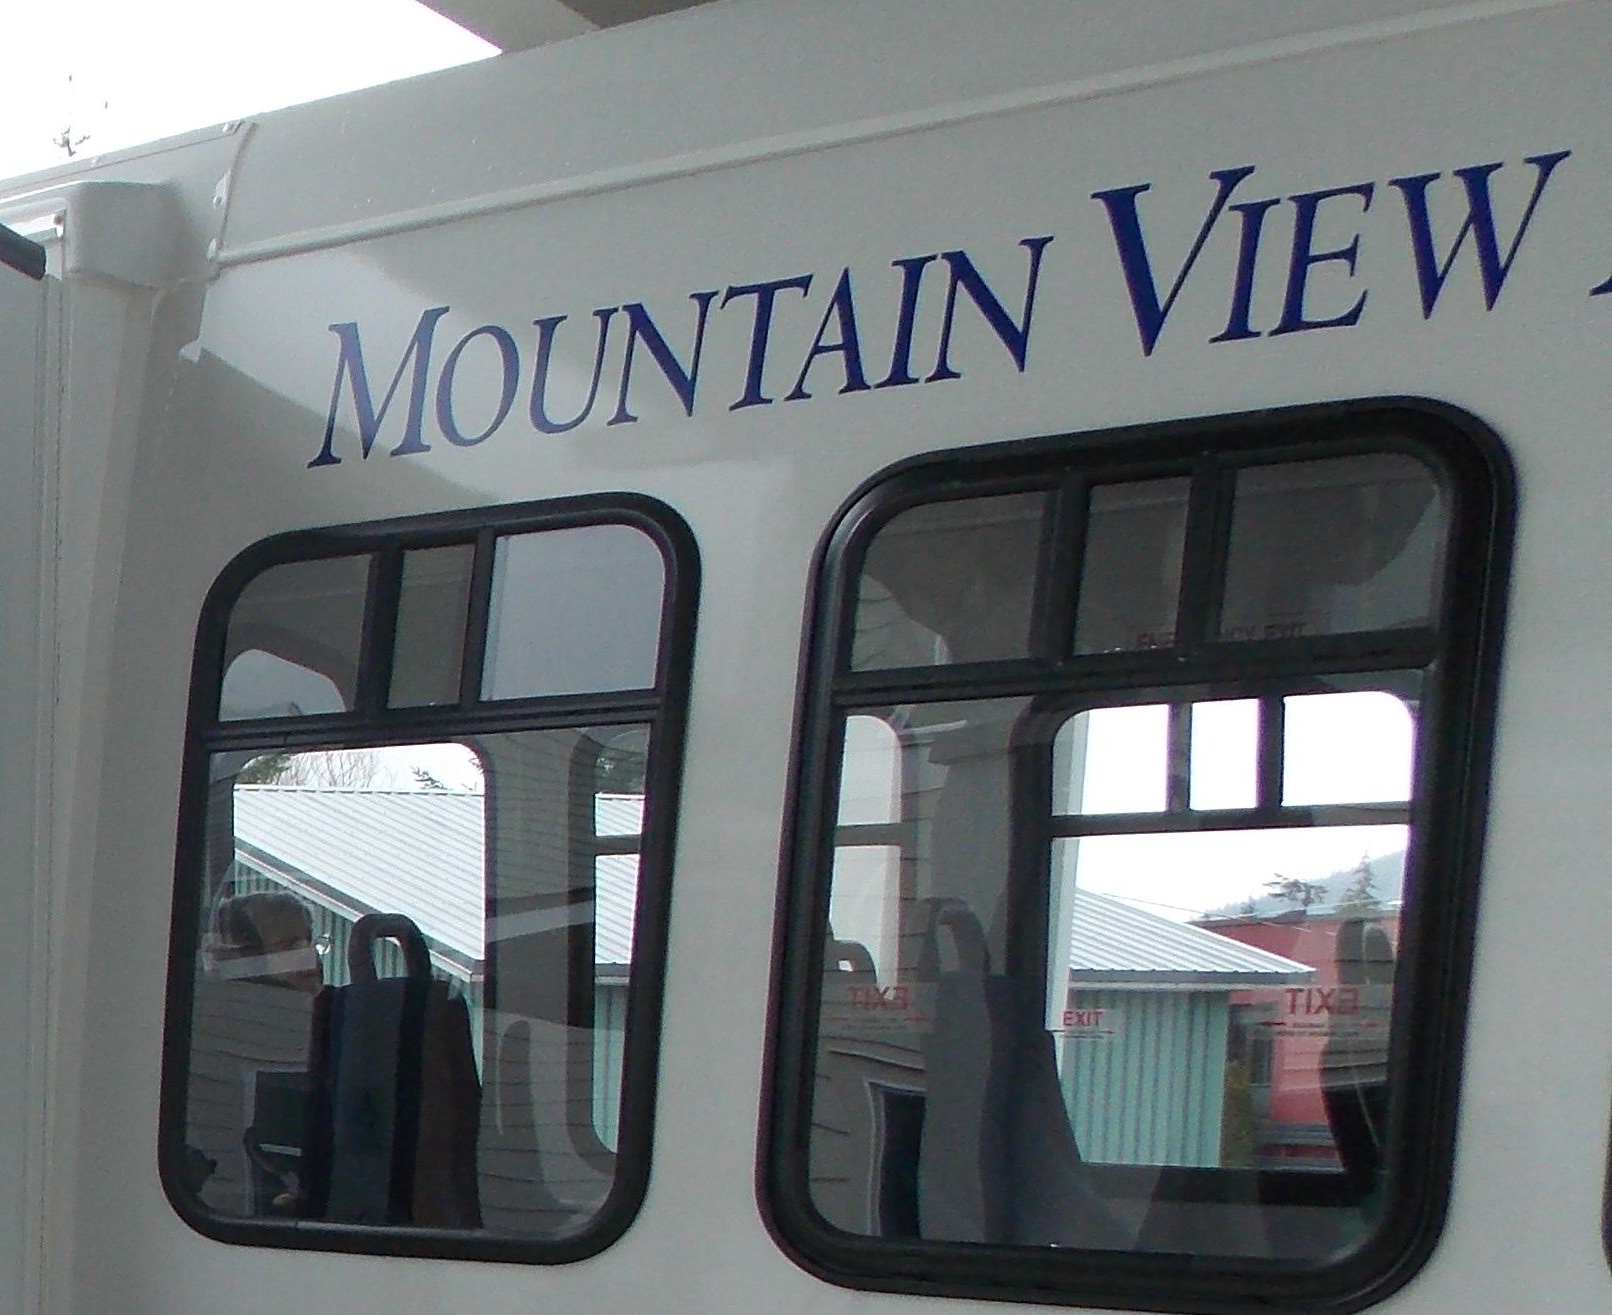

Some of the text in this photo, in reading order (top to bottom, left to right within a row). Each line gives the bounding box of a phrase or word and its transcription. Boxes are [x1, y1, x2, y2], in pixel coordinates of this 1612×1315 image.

[307, 149, 1572, 470] MOUNTAIN VIEW
[1063, 1010, 1103, 1026] EXIT
